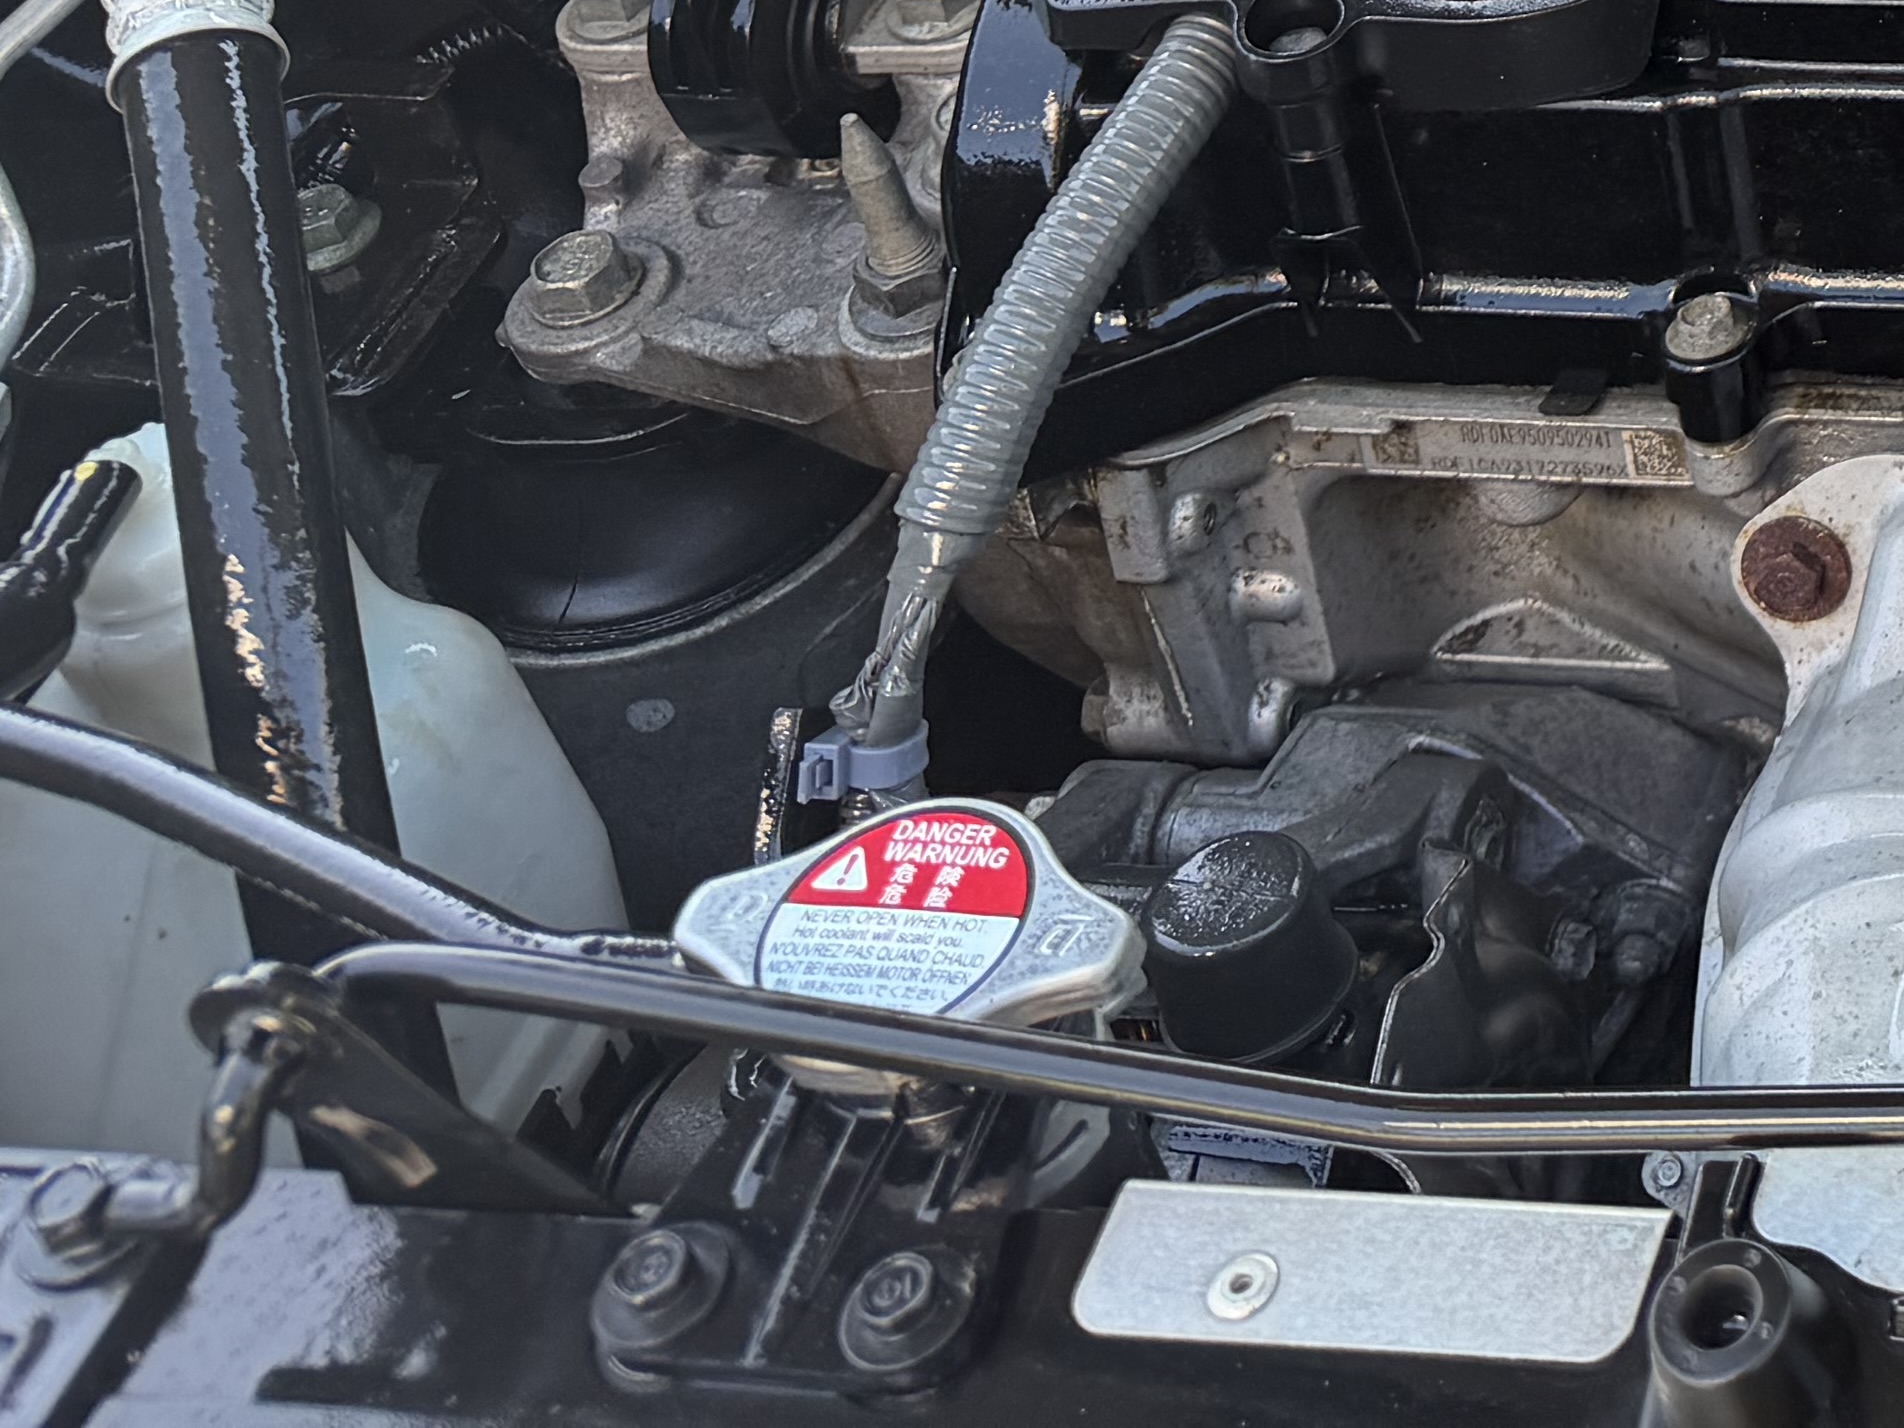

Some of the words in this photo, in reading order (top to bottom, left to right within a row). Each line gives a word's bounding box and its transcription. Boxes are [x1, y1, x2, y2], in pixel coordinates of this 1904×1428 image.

[892, 819, 997, 846] DANGER
[884, 840, 1010, 869] WARNUNG
[800, 909, 855, 924] NEVER
[856, 911, 900, 927] OPEN
[903, 913, 951, 931] WHEN
[792, 924, 819, 940] Hot
[819, 926, 870, 942] coolant
[872, 928, 896, 942] will
[896, 931, 935, 945] scald
[843, 943, 875, 960] PAS
[876, 945, 930, 964] QUAND
[766, 959, 804, 974] NICHT
[802, 960, 824, 976] BEI
[876, 964, 922, 982] MOTOR
